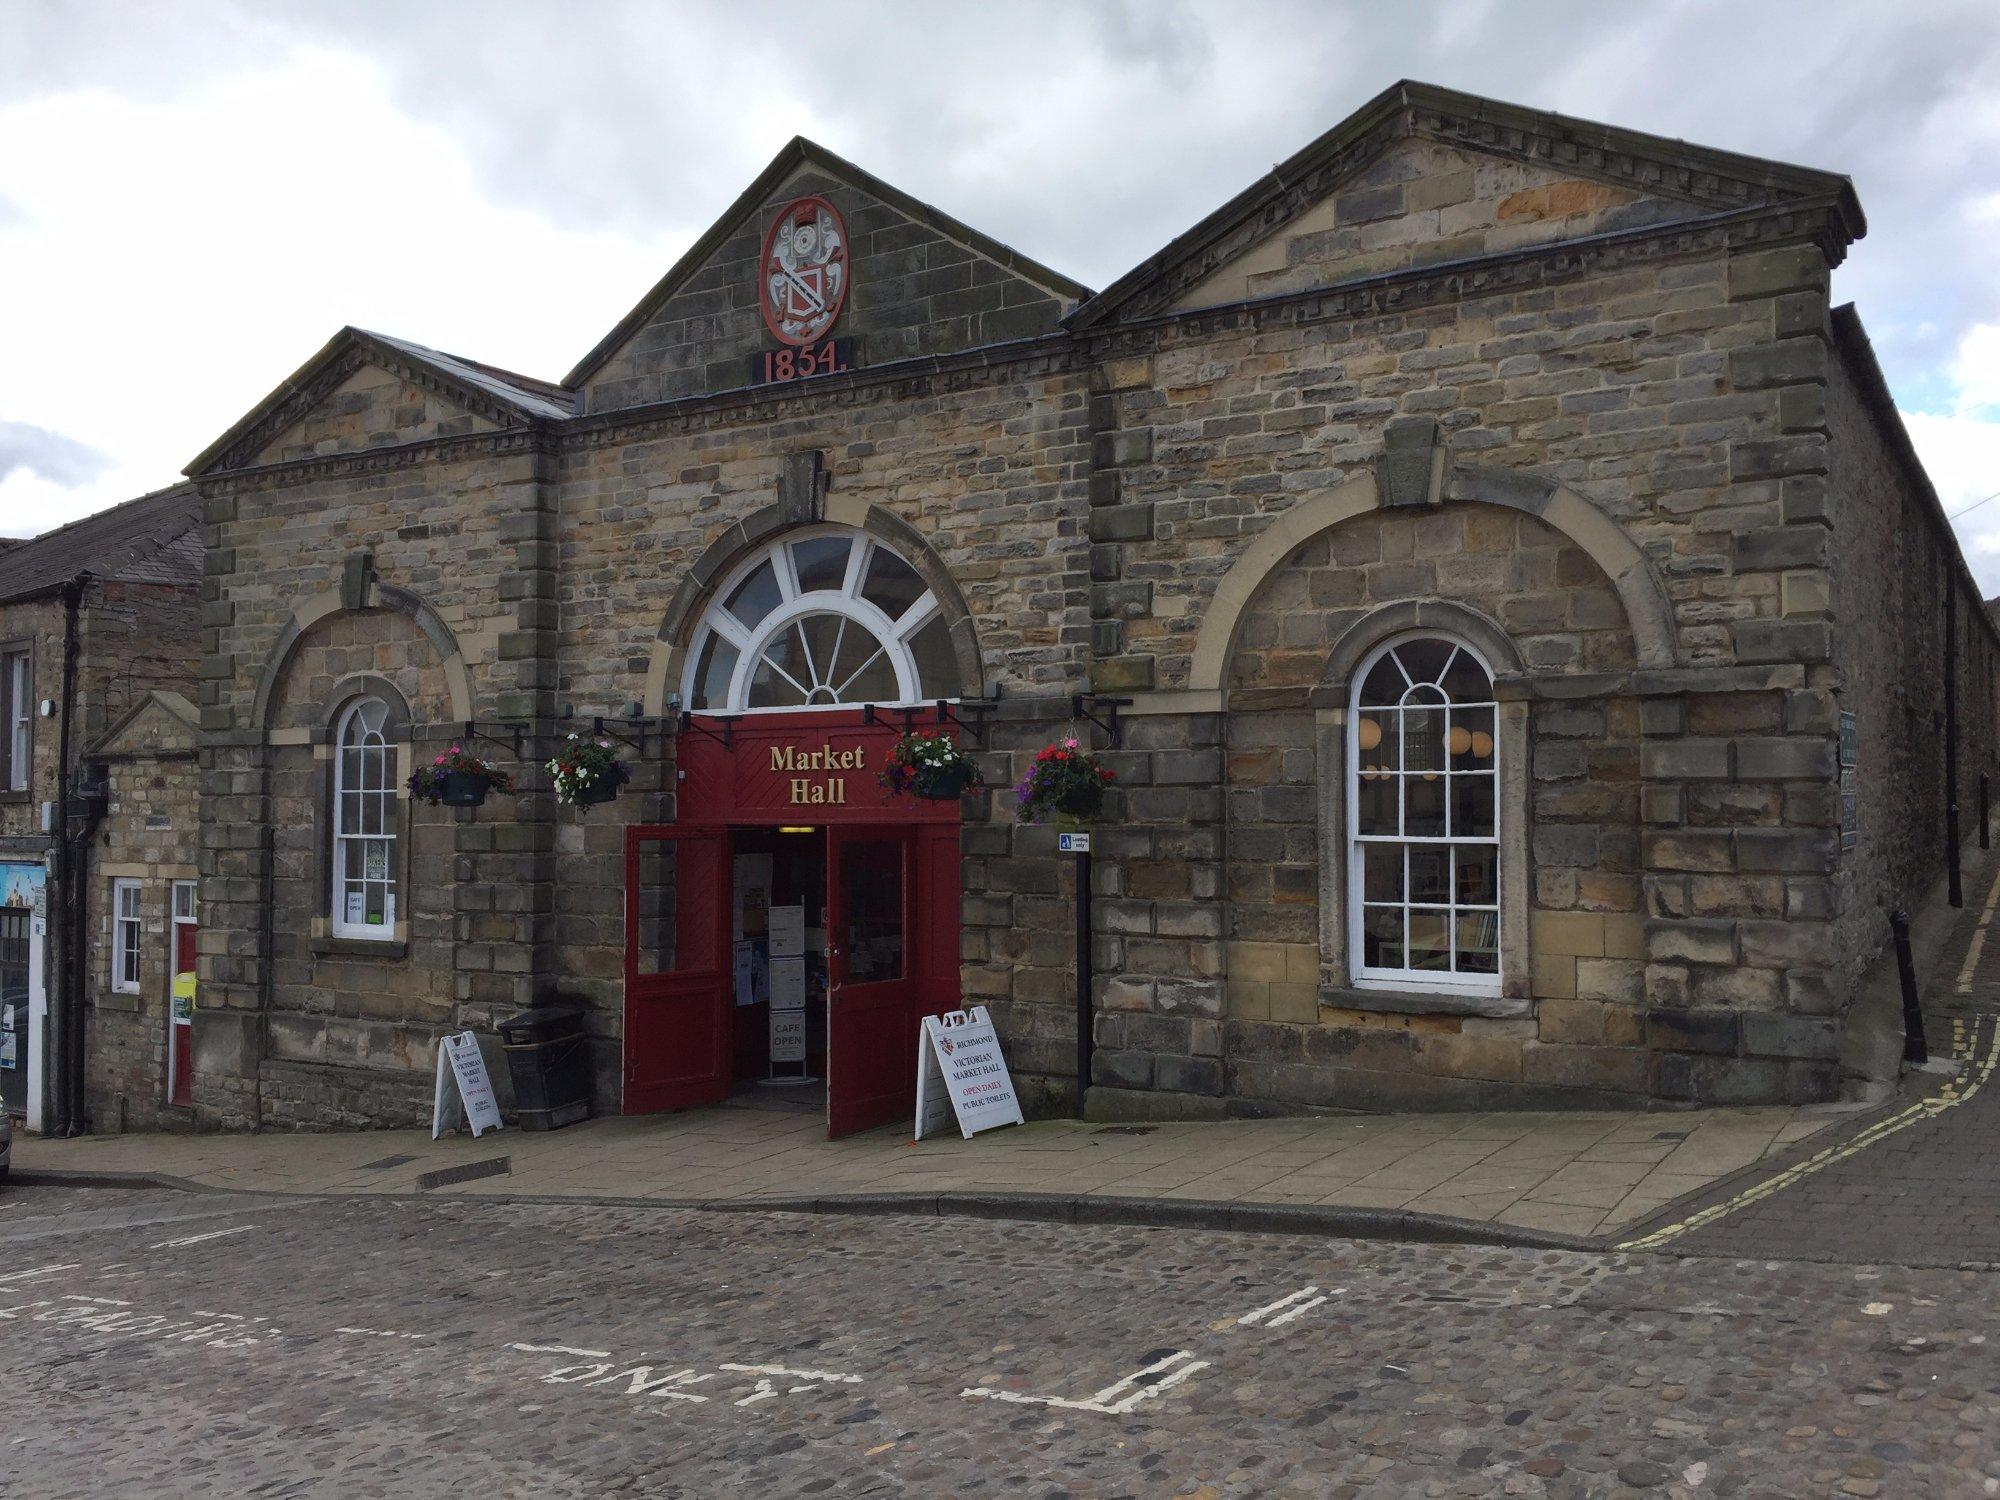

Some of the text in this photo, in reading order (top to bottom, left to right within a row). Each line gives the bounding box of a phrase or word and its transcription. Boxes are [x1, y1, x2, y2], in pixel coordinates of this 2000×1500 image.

[770, 744, 865, 771] Market
[790, 778, 846, 804] Hall
[774, 1024, 801, 1034] CAFE
[774, 1036, 802, 1046] OPEN
[956, 1035, 993, 1049] RICHMOND
[953, 1052, 993, 1067] VICTORIAN
[952, 1063, 1001, 1081] MARKET HALL
[962, 1080, 1002, 1096] OPEN DAILY
[962, 1091, 1011, 1110] PUBLIC TOILETS
